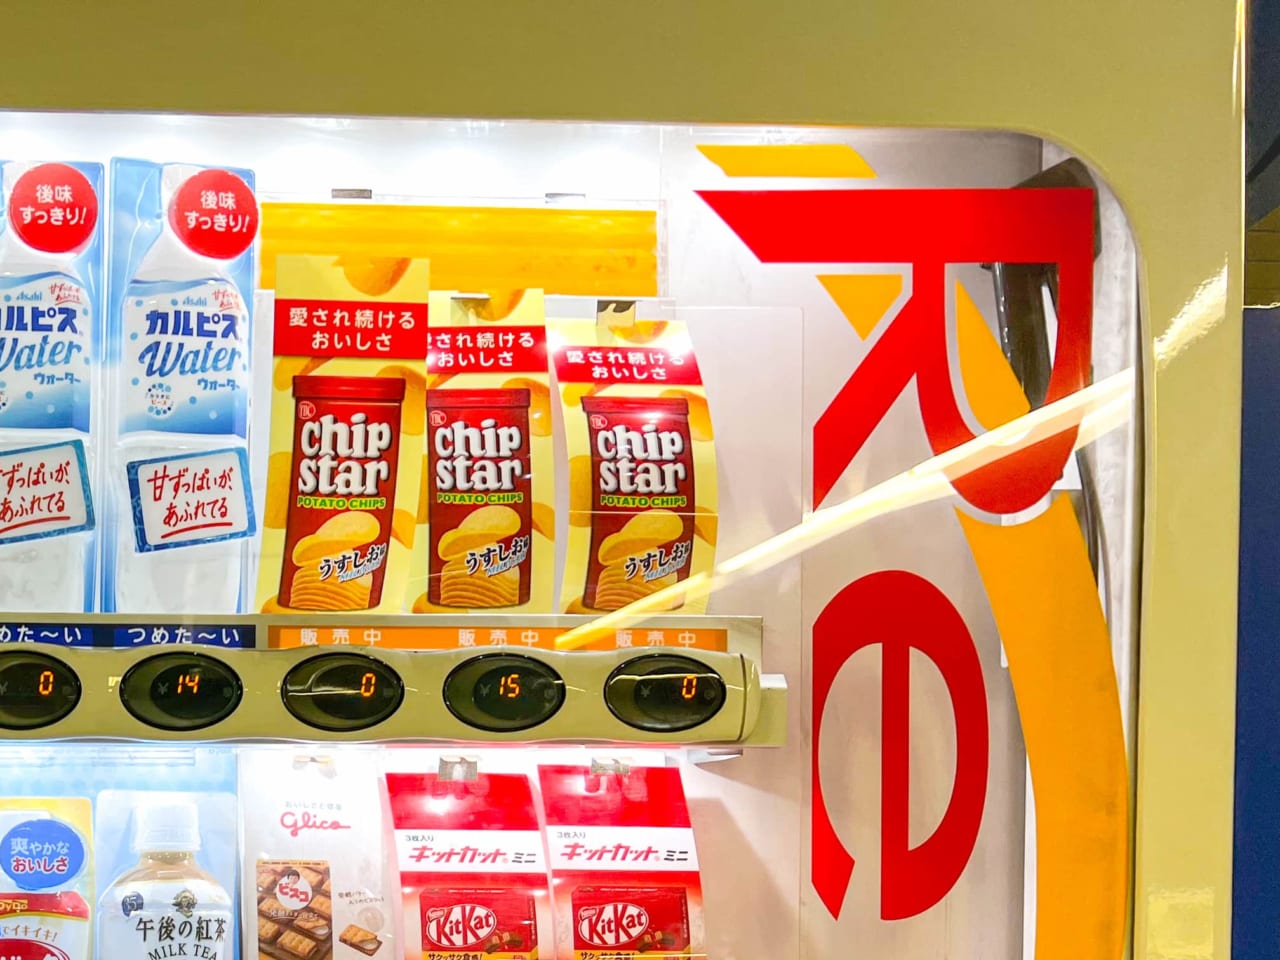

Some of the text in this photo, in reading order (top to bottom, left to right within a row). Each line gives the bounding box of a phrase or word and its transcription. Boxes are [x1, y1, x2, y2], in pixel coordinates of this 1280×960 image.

[36, 185, 72, 203] 後味
[201, 192, 236, 209] 後味
[145, 310, 241, 340] カルピス
[288, 307, 416, 328] 愛され続ける
[311, 330, 392, 351] おいしさ
[137, 337, 242, 379] Water
[437, 350, 513, 367] おいしさ
[592, 364, 667, 380] おいしさ
[301, 413, 391, 459] chip
[435, 418, 521, 459] chip
[297, 456, 389, 496] star
[435, 456, 522, 494] star
[599, 457, 687, 494] star
[297, 496, 385, 509] POTATO CHIPS
[436, 492, 522, 504] POTATO CHIPS
[600, 495, 686, 507] POTATO CHIPS
[163, 497, 228, 527] あふれてる
[301, 629, 381, 645] 販売中
[458, 629, 539, 645] 販売中
[39, 671, 53, 695] 0
[280, 812, 351, 837] Glico
[10, 837, 69, 855] 爽やかな
[278, 880, 311, 903] ビスコ
[435, 906, 492, 946] KitKat
